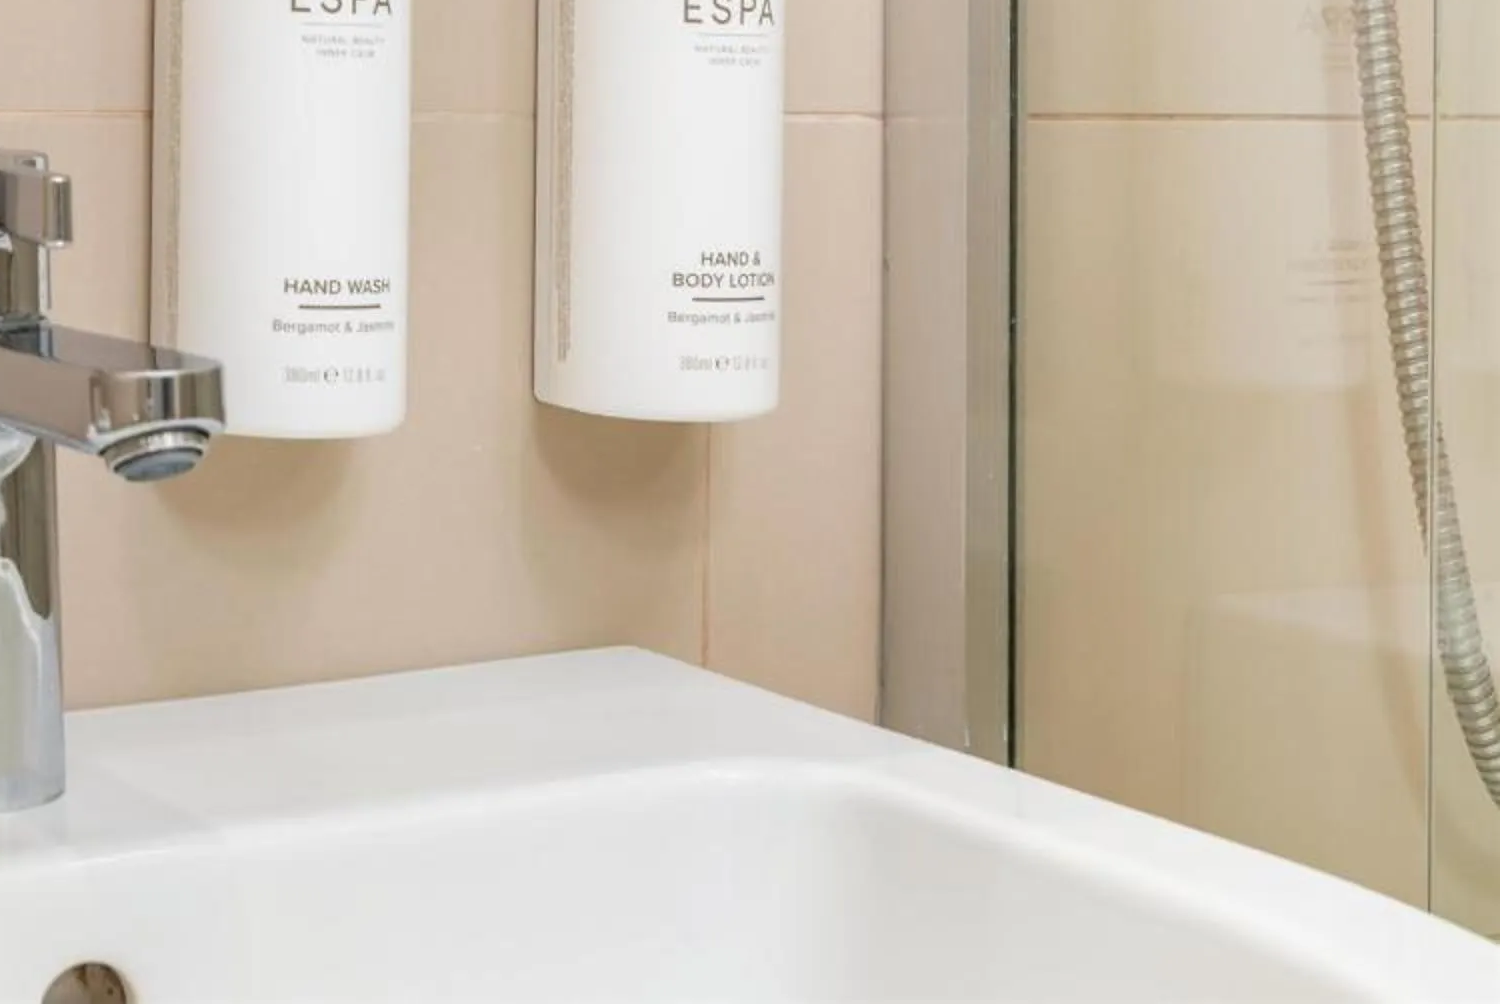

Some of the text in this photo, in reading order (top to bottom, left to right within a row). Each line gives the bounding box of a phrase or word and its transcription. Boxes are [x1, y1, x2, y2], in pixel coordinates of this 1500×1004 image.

[701, 251, 761, 266] HAND &
[283, 277, 390, 295] HAND WASH
[673, 272, 775, 289] BODY LOTION
[272, 318, 341, 336] Bergamot
[344, 320, 353, 332] &
[668, 311, 731, 326] Bergamot
